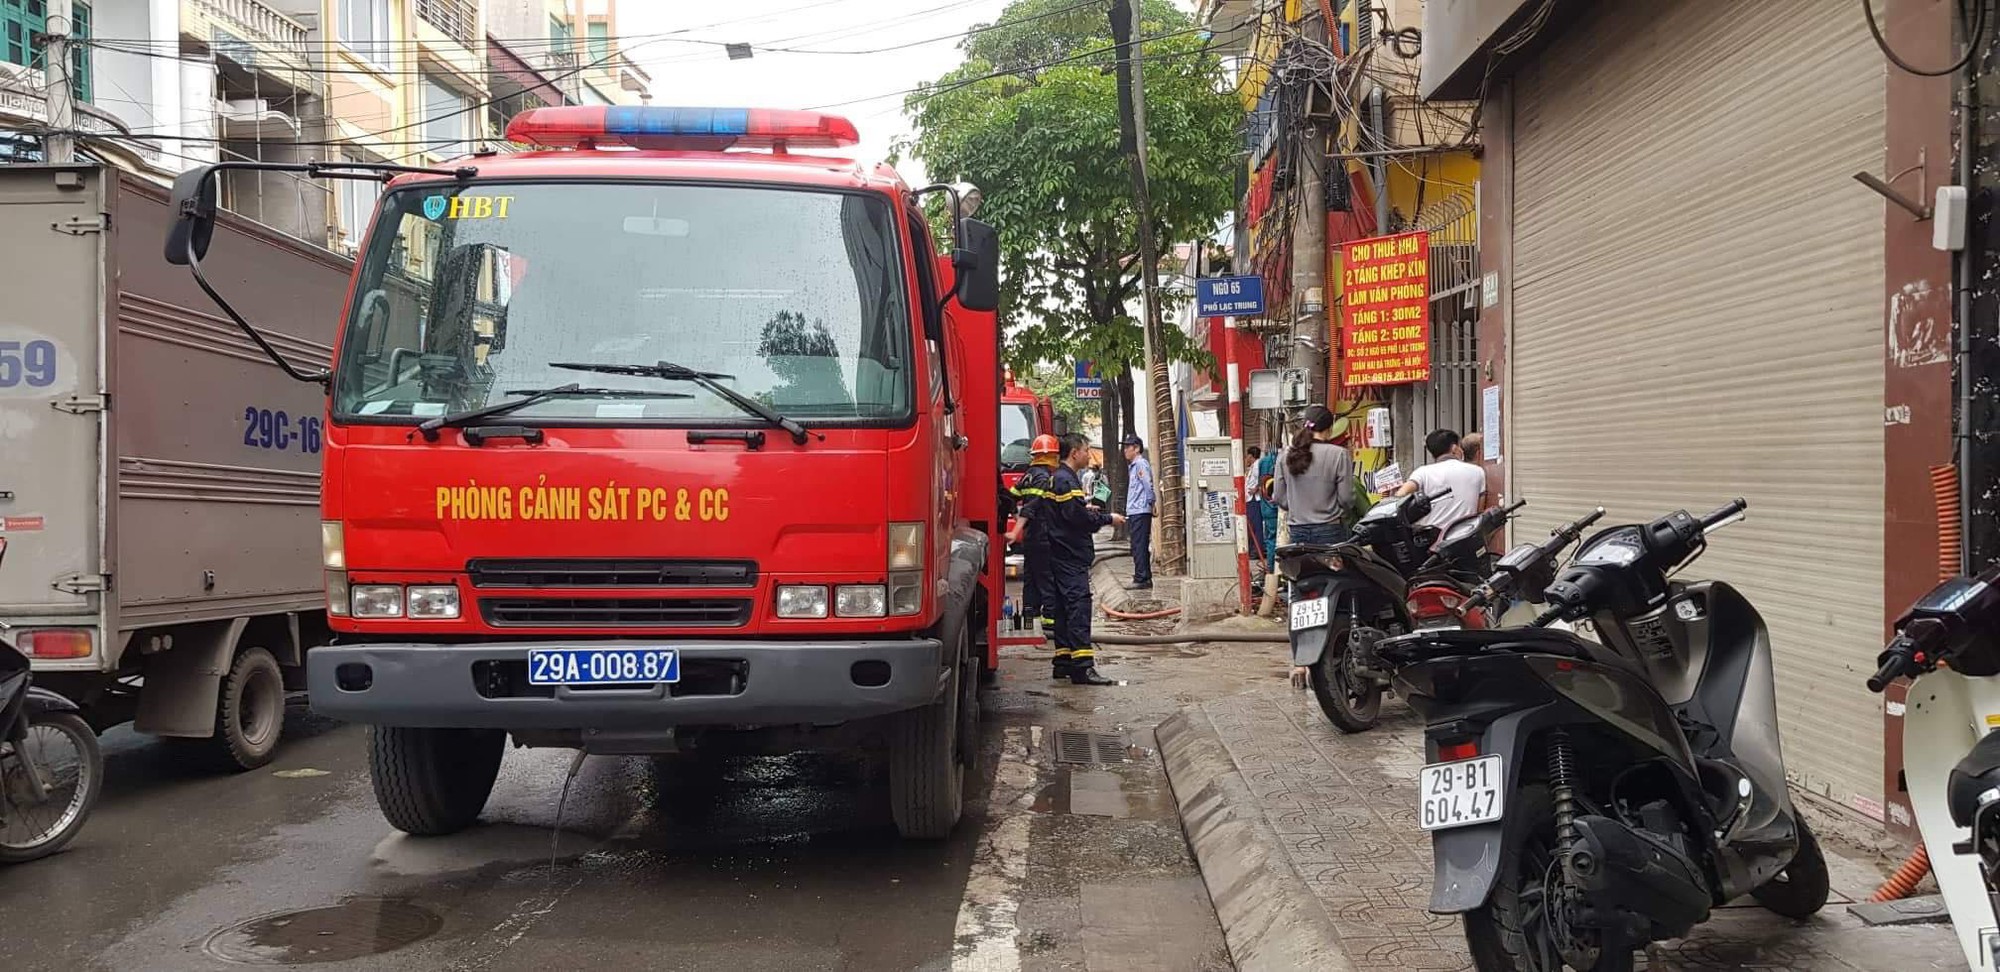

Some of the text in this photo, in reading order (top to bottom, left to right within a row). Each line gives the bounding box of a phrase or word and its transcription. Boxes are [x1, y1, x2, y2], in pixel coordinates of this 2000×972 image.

[448, 196, 515, 219] HBT
[1351, 245, 1370, 262] CHO
[1373, 238, 1396, 259] THUÊ
[1346, 270, 1352, 286] 2
[1380, 260, 1406, 281] KHÉP
[1408, 257, 1426, 277] KÍN
[1230, 281, 1241, 295] 65
[1348, 281, 1424, 306] LÀM VĂN PHÒNG
[1234, 301, 1258, 310] TRUNG
[1391, 306, 1422, 321] 30M2
[1380, 328, 1390, 342] 2:
[1392, 325, 1422, 341] 50M2
[1078, 389, 1090, 397] PV
[244, 406, 324, 454] 29C-16
[436, 474, 729, 522] PHÒNG CẢNH SÁT PC & CC
[1293, 611, 1325, 628] 301.73
[533, 651, 674, 681] 29A-008.87
[1431, 761, 1487, 795] 29-B1
[1425, 789, 1496, 825] 604.47
